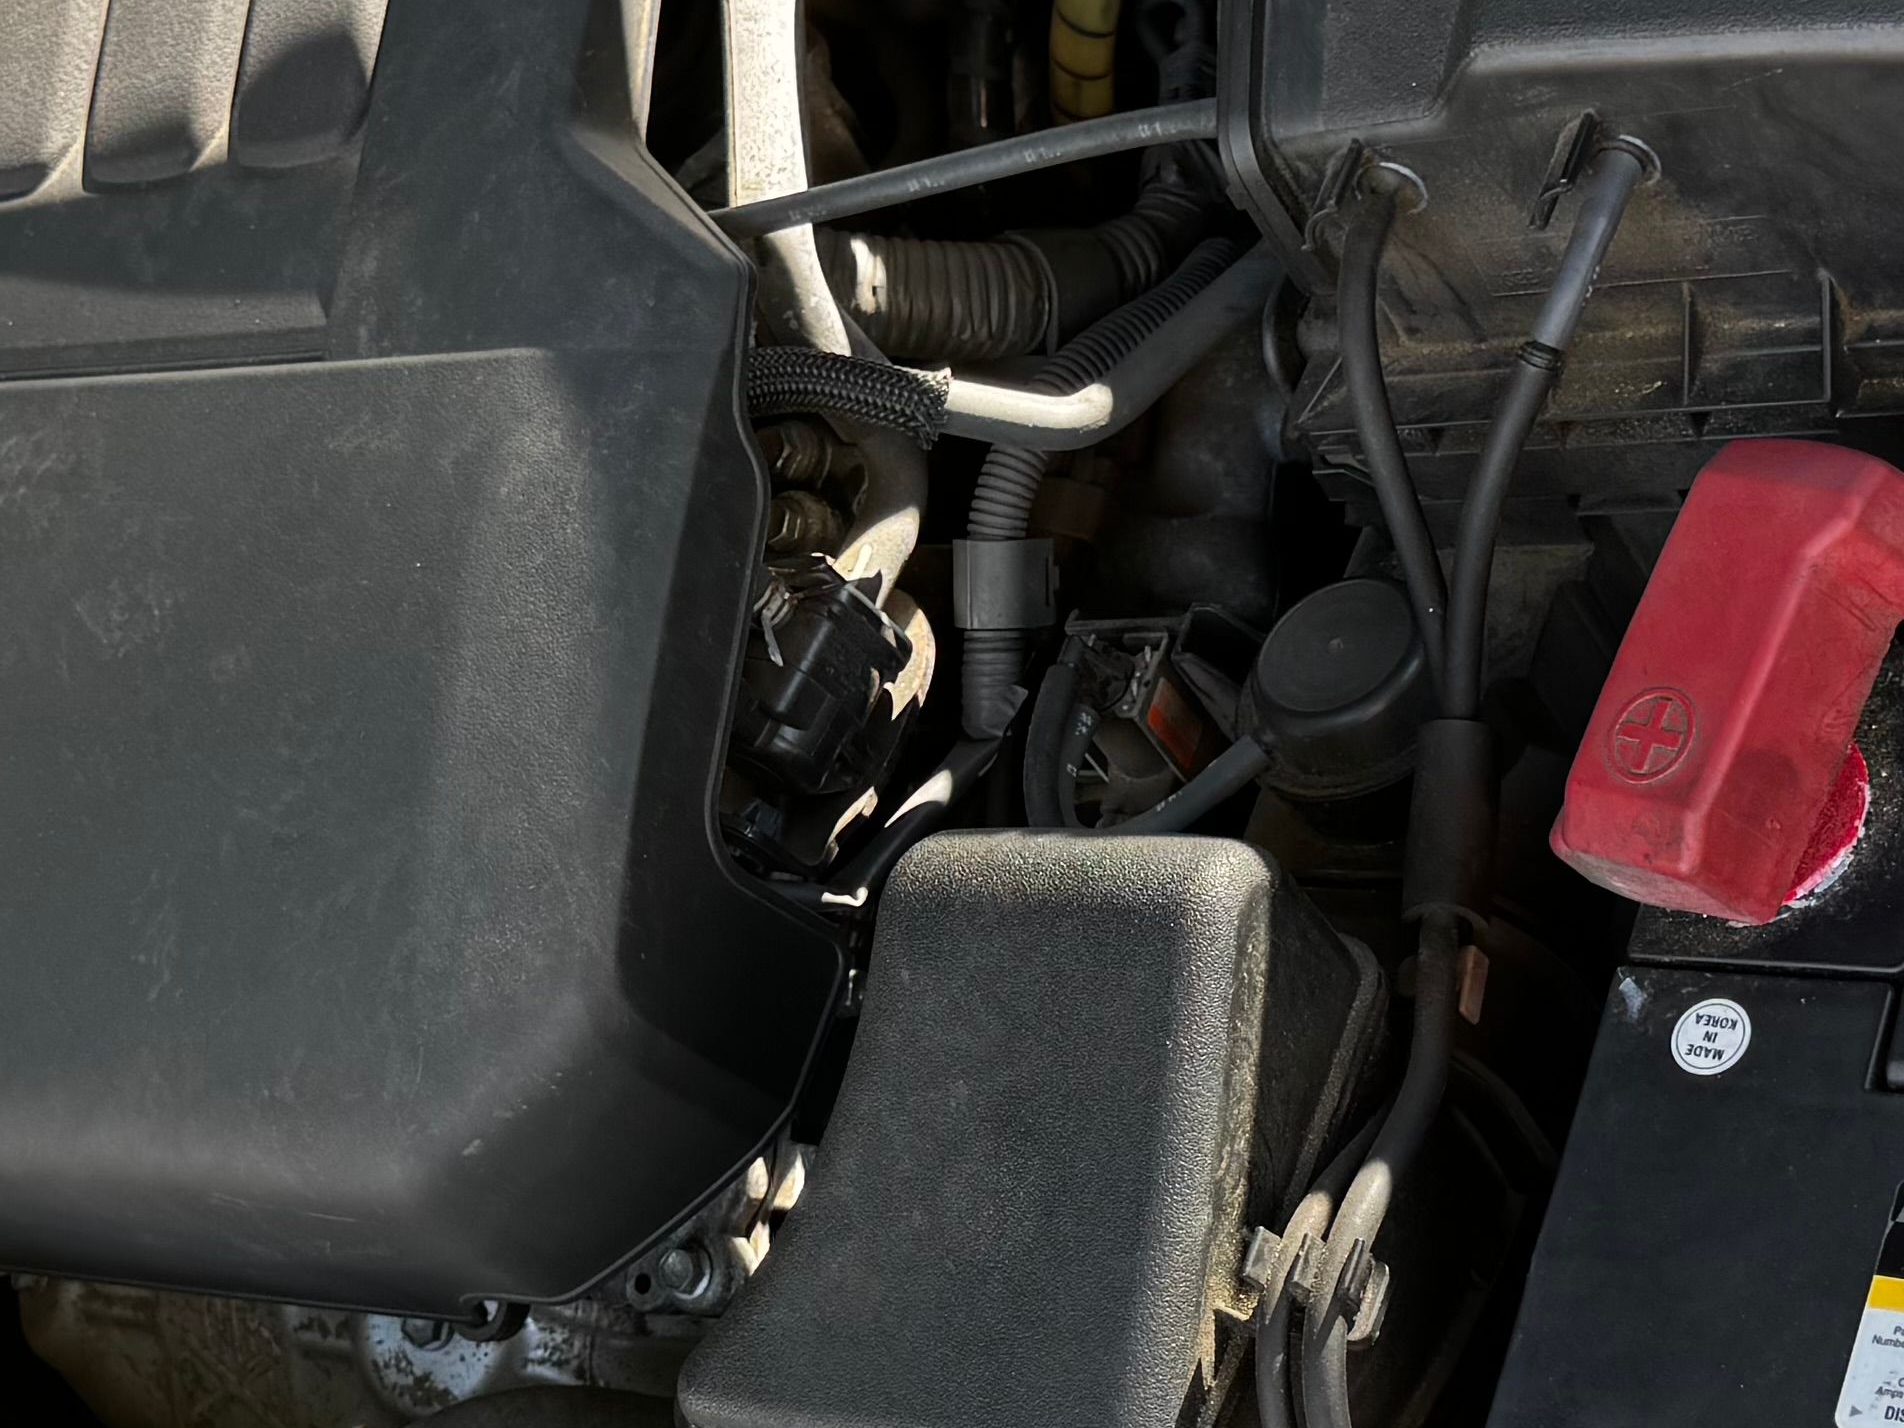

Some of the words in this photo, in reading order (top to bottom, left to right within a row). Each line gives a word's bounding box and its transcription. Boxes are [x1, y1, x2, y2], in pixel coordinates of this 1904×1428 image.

[1695, 1012, 1738, 1030] KOREA
[1703, 1031, 1718, 1043] IN
[1685, 1044, 1725, 1061] MADE
